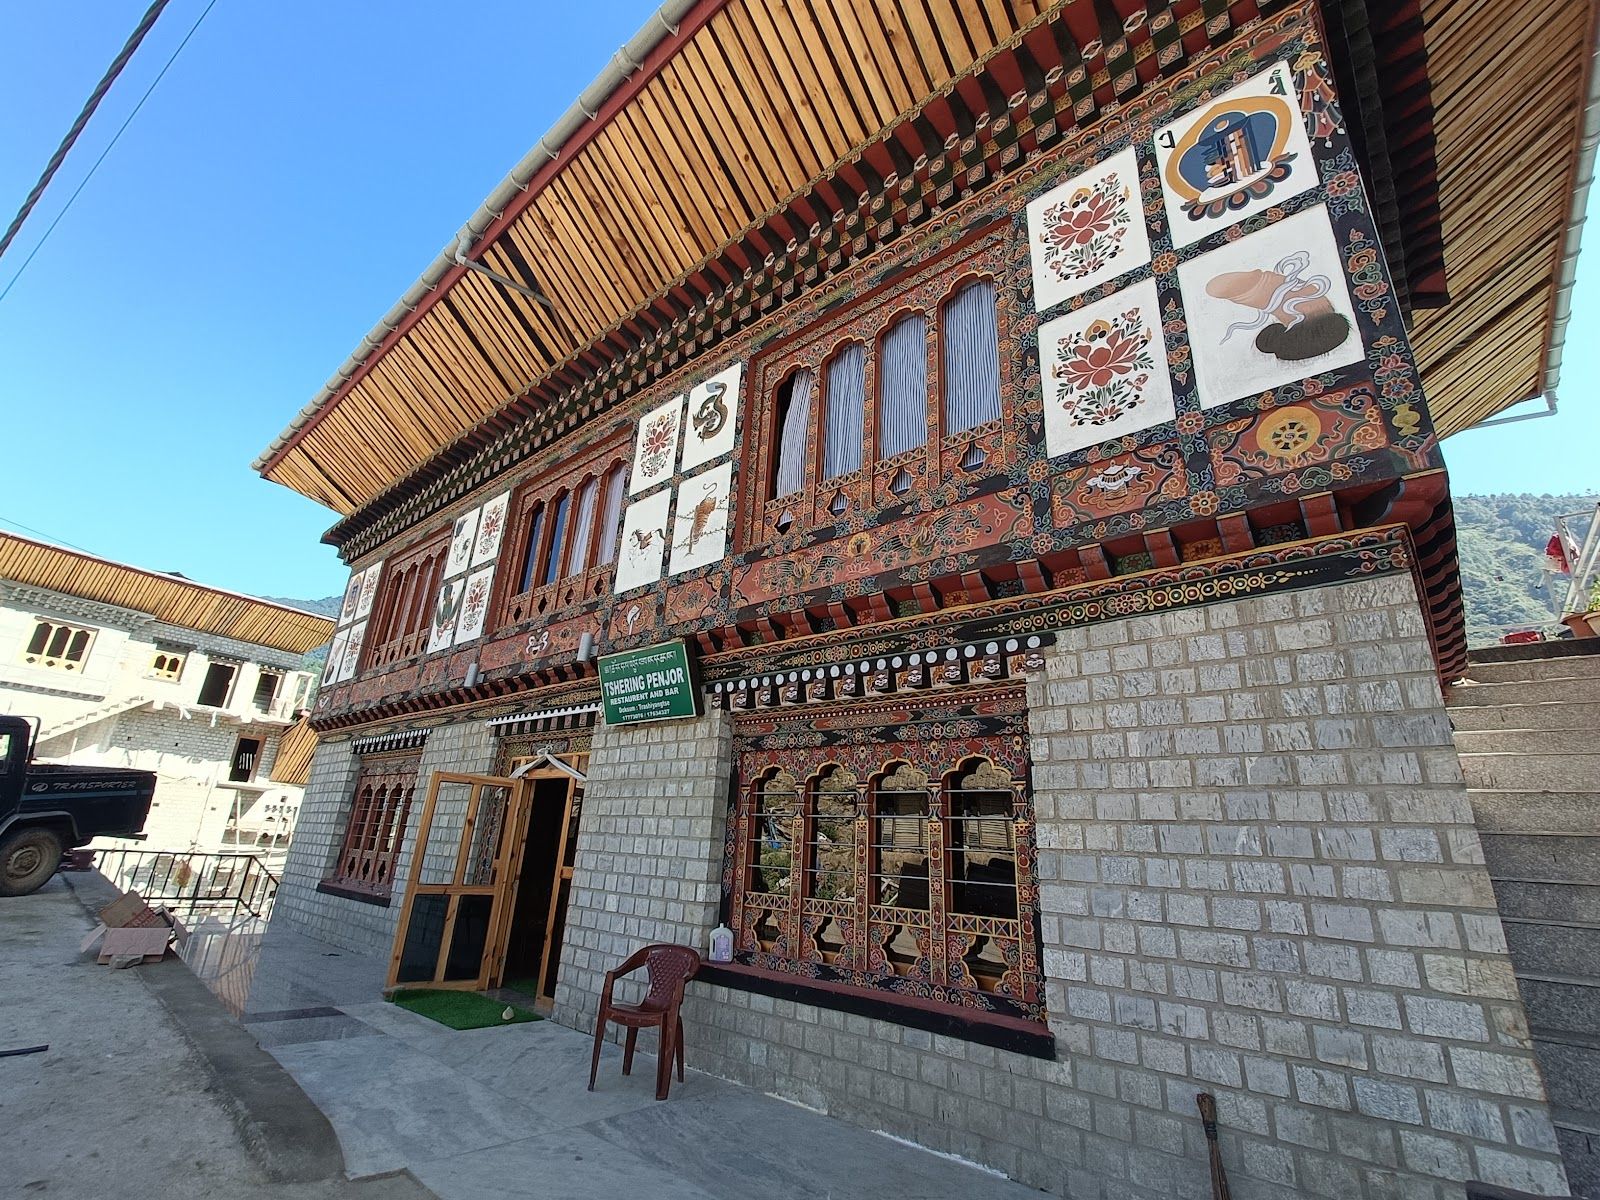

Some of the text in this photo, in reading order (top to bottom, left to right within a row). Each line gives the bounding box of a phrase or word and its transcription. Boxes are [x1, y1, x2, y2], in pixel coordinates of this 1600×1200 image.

[604, 667, 685, 697] TSHERING PENJOR
[649, 690, 663, 699] AND
[664, 687, 679, 696] BAR
[53, 780, 137, 791] TRANSPORTER
